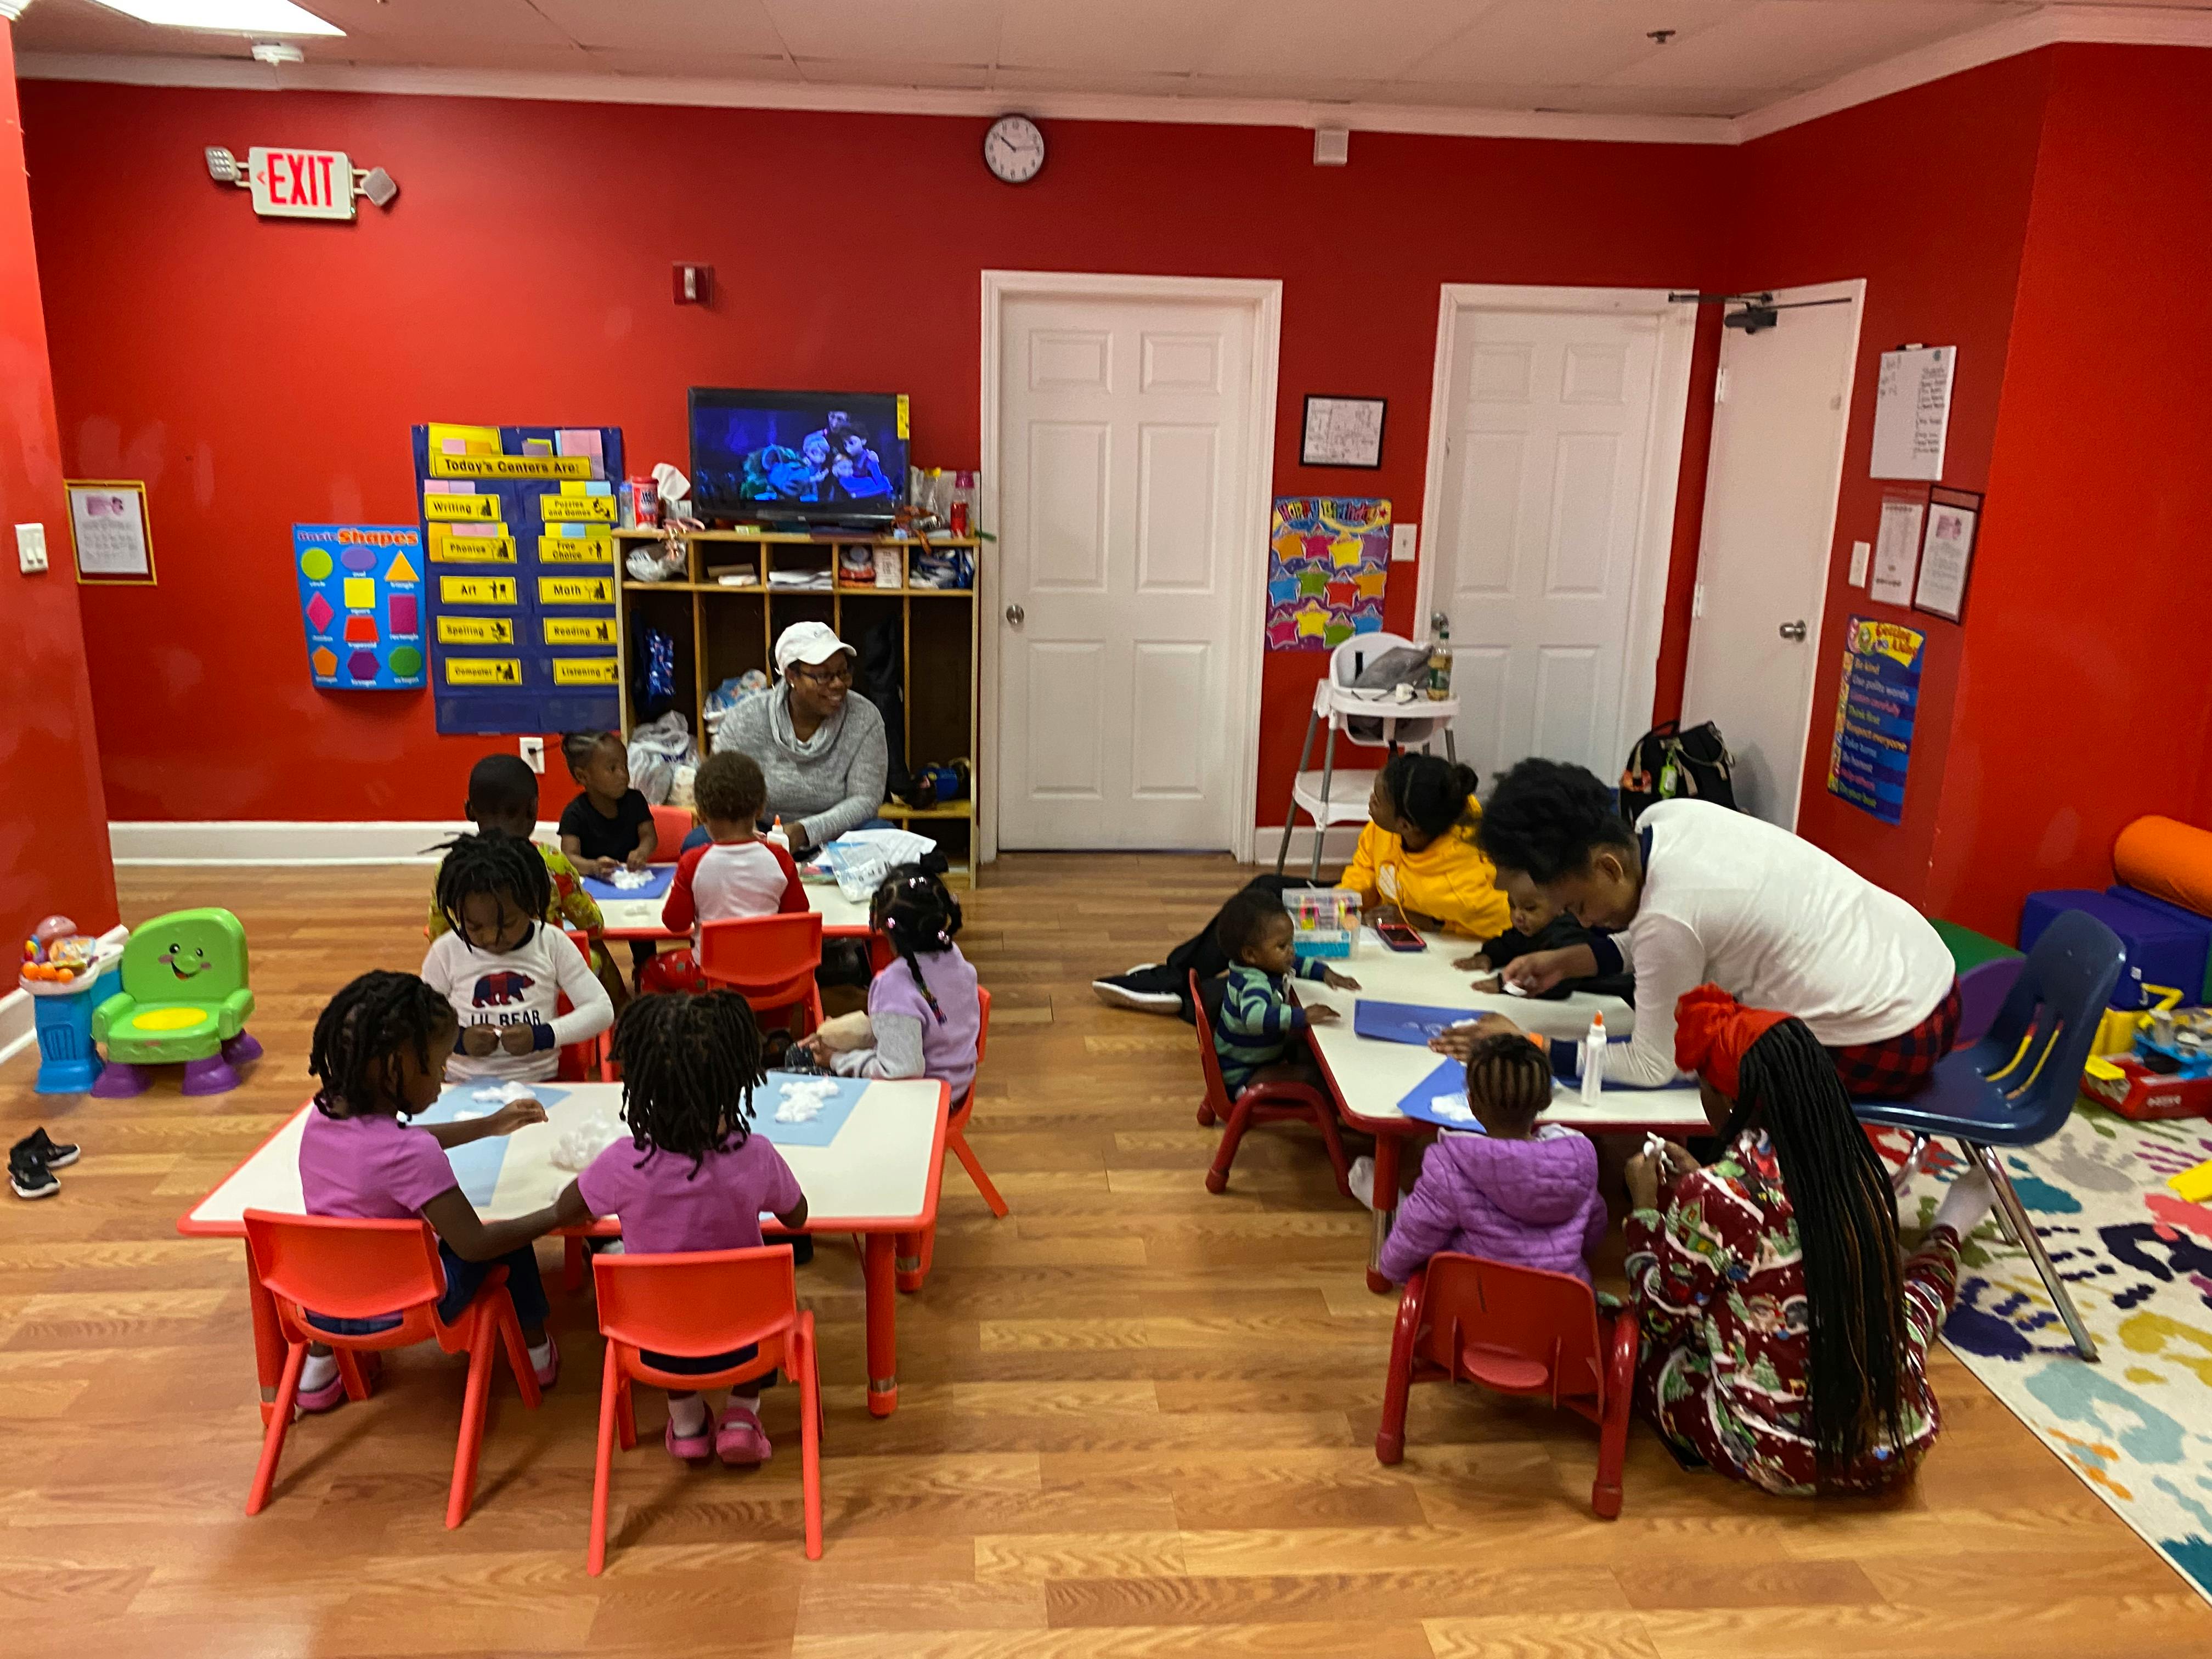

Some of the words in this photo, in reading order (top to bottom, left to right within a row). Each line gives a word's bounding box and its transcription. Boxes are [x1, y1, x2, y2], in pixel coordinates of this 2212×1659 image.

[266, 153, 334, 207] EXIT
[445, 459, 494, 475] Today's
[497, 460, 548, 473] Centers
[433, 500, 472, 515] Writing
[548, 509, 563, 517] and
[337, 528, 418, 548] Shapes
[449, 543, 487, 555] Phonics
[556, 541, 576, 550] Free
[552, 550, 583, 560] Choice
[460, 583, 477, 595] Art
[554, 584, 582, 596] Math
[446, 624, 484, 638] Spelling
[554, 626, 591, 637] Reading
[454, 666, 493, 679] Computer
[561, 667, 601, 679] Listening
[499, 1009, 541, 1026] BEAR
